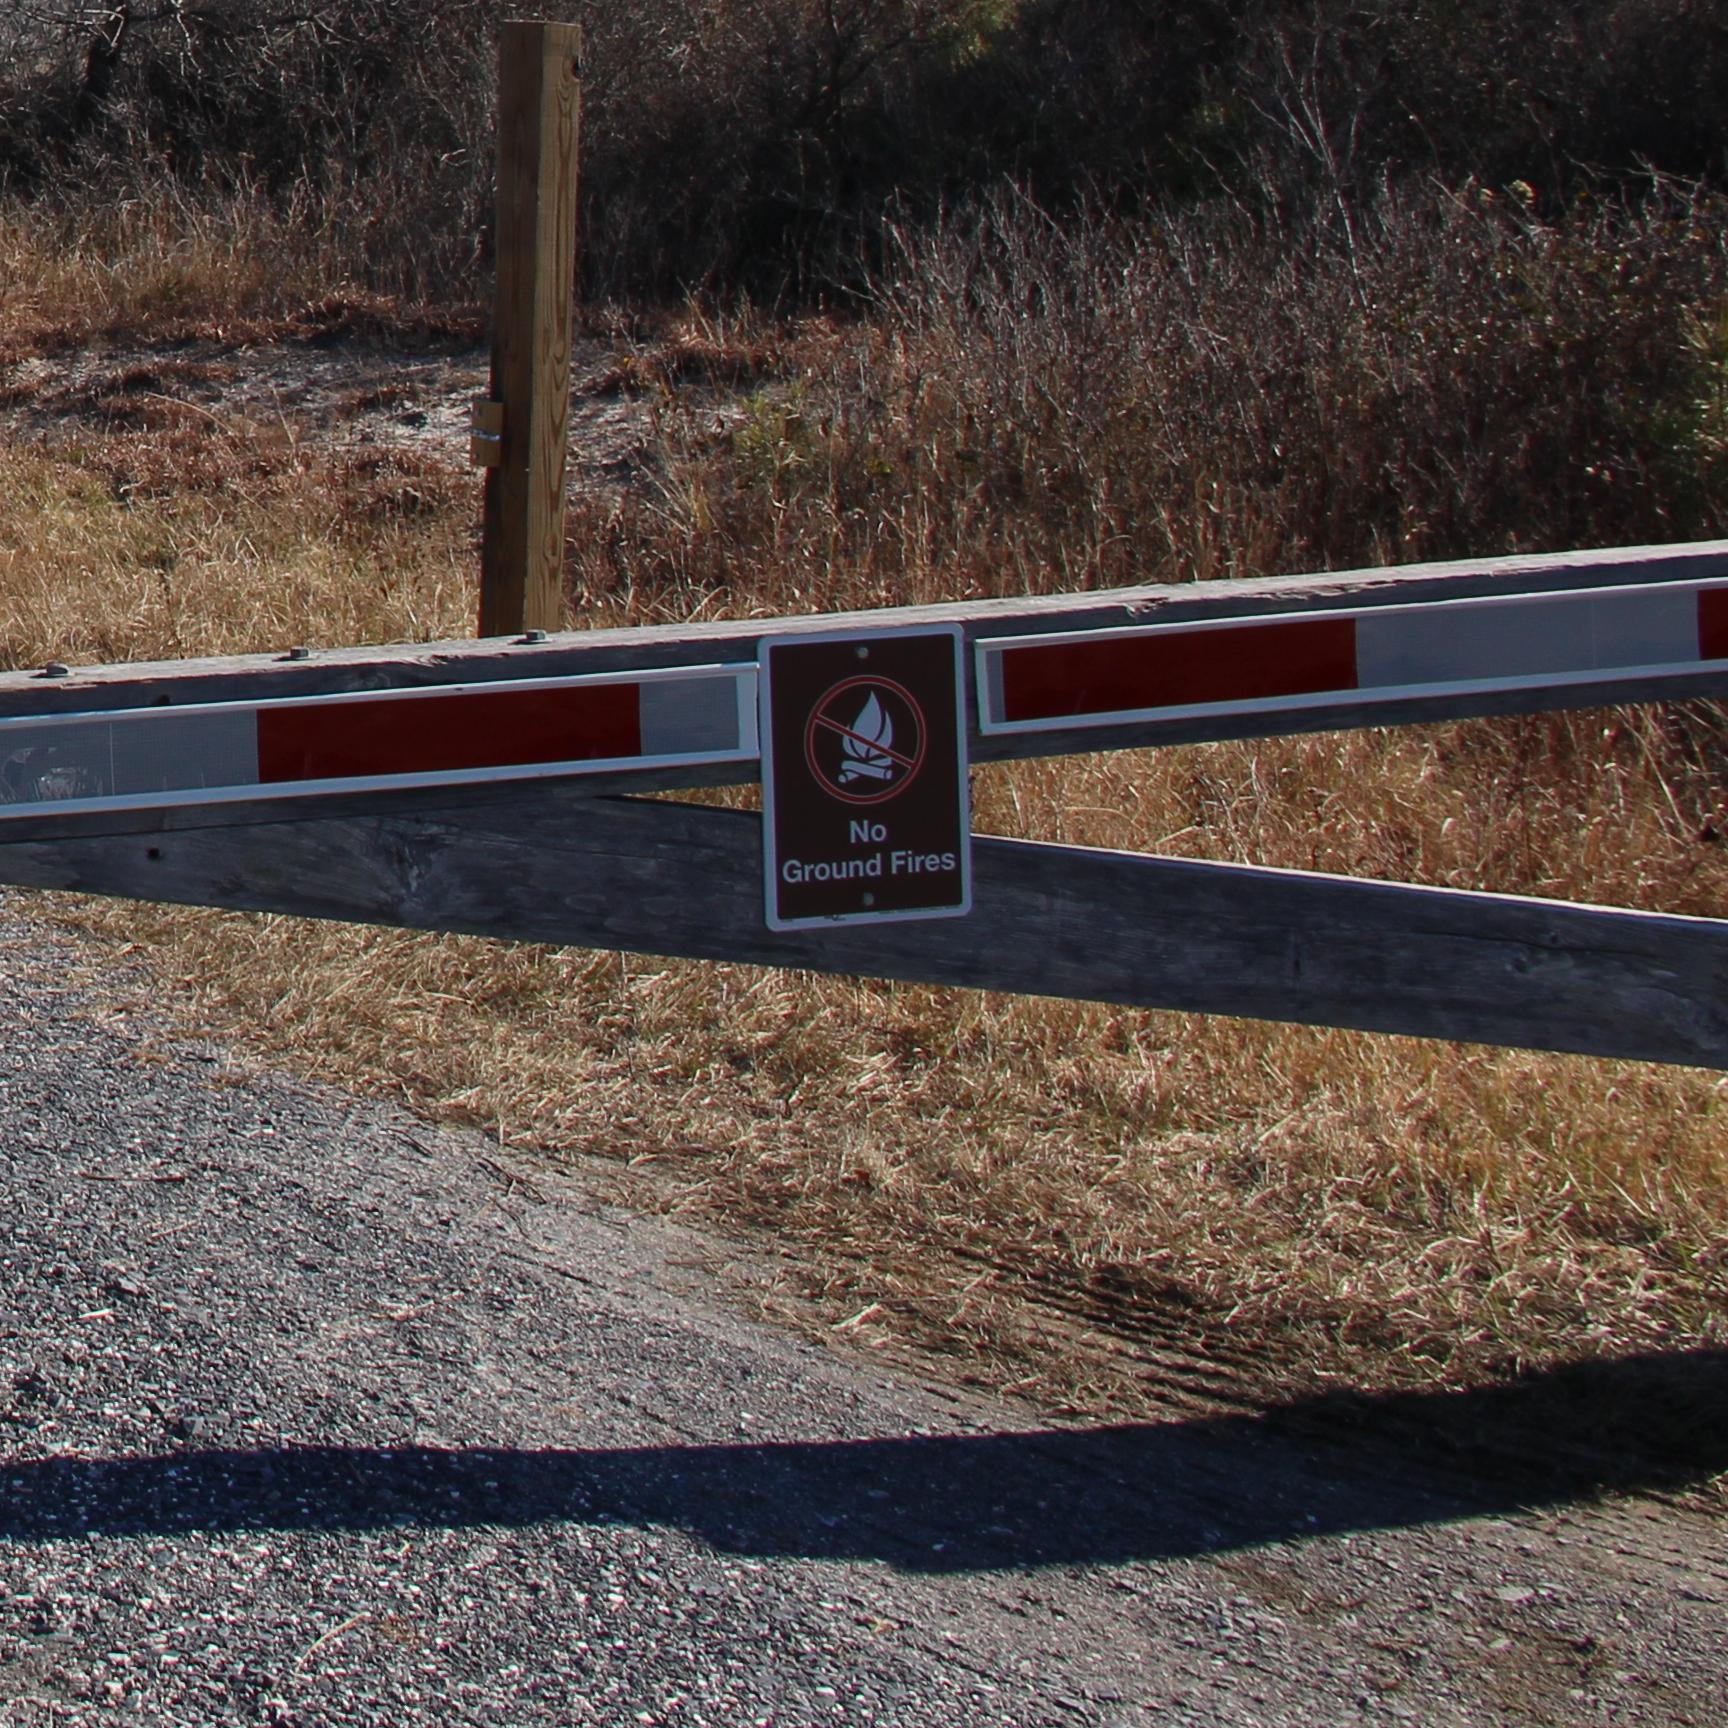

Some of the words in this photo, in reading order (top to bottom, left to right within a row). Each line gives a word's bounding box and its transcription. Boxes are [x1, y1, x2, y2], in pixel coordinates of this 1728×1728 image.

[849, 819, 888, 844] No
[782, 853, 883, 884] Ground
[890, 849, 957, 875] Fires
